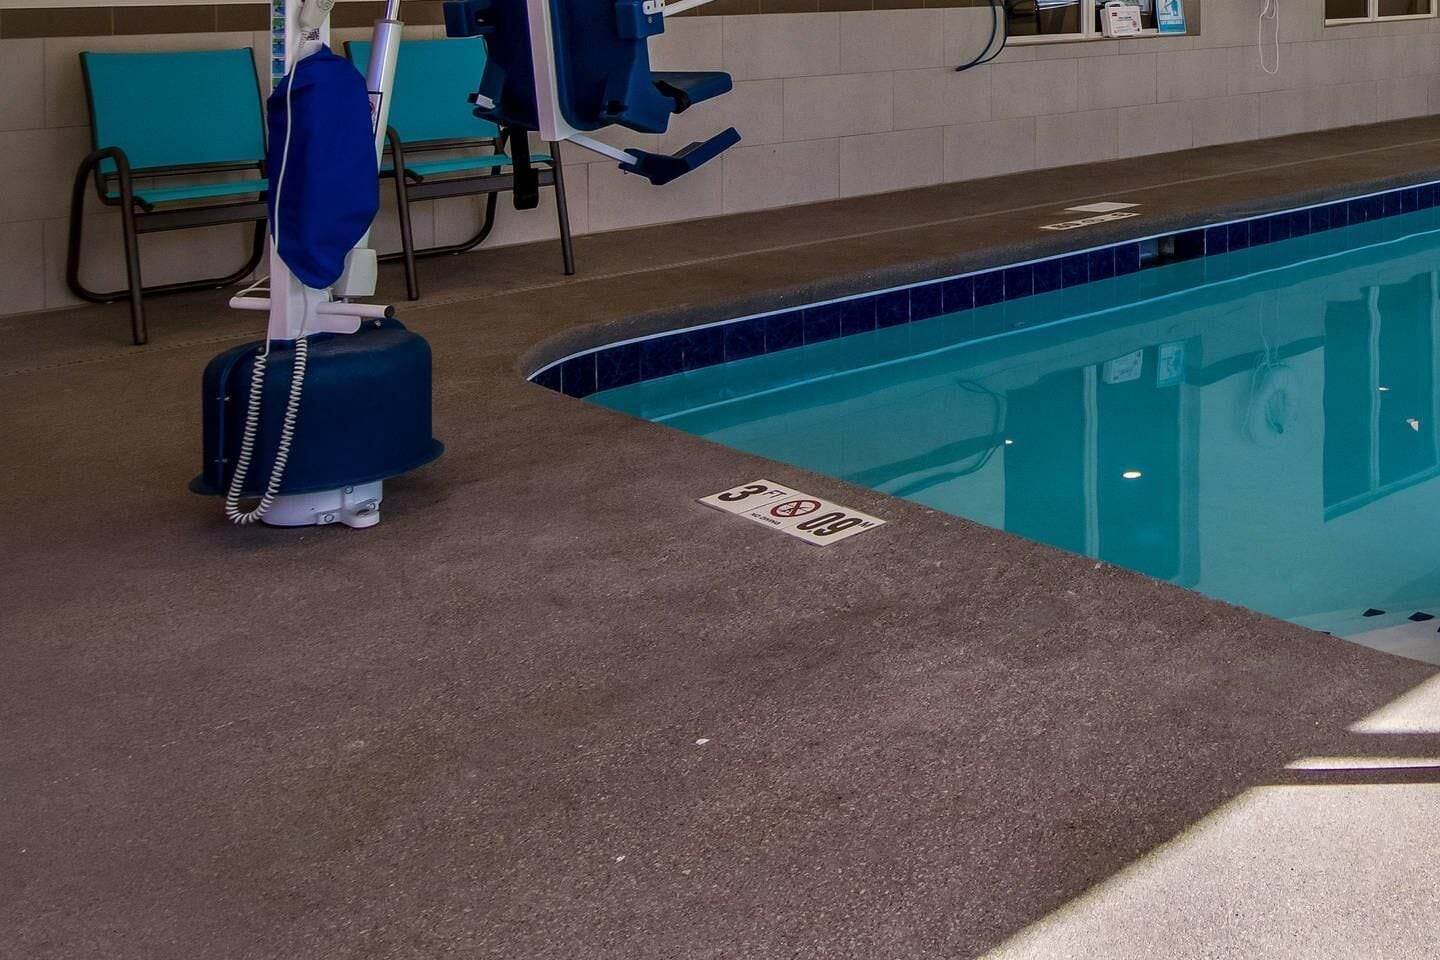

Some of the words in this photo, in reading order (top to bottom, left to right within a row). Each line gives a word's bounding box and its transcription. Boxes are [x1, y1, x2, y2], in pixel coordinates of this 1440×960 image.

[717, 484, 769, 502] 3
[762, 489, 787, 499] FT
[796, 511, 864, 537] 0.9
